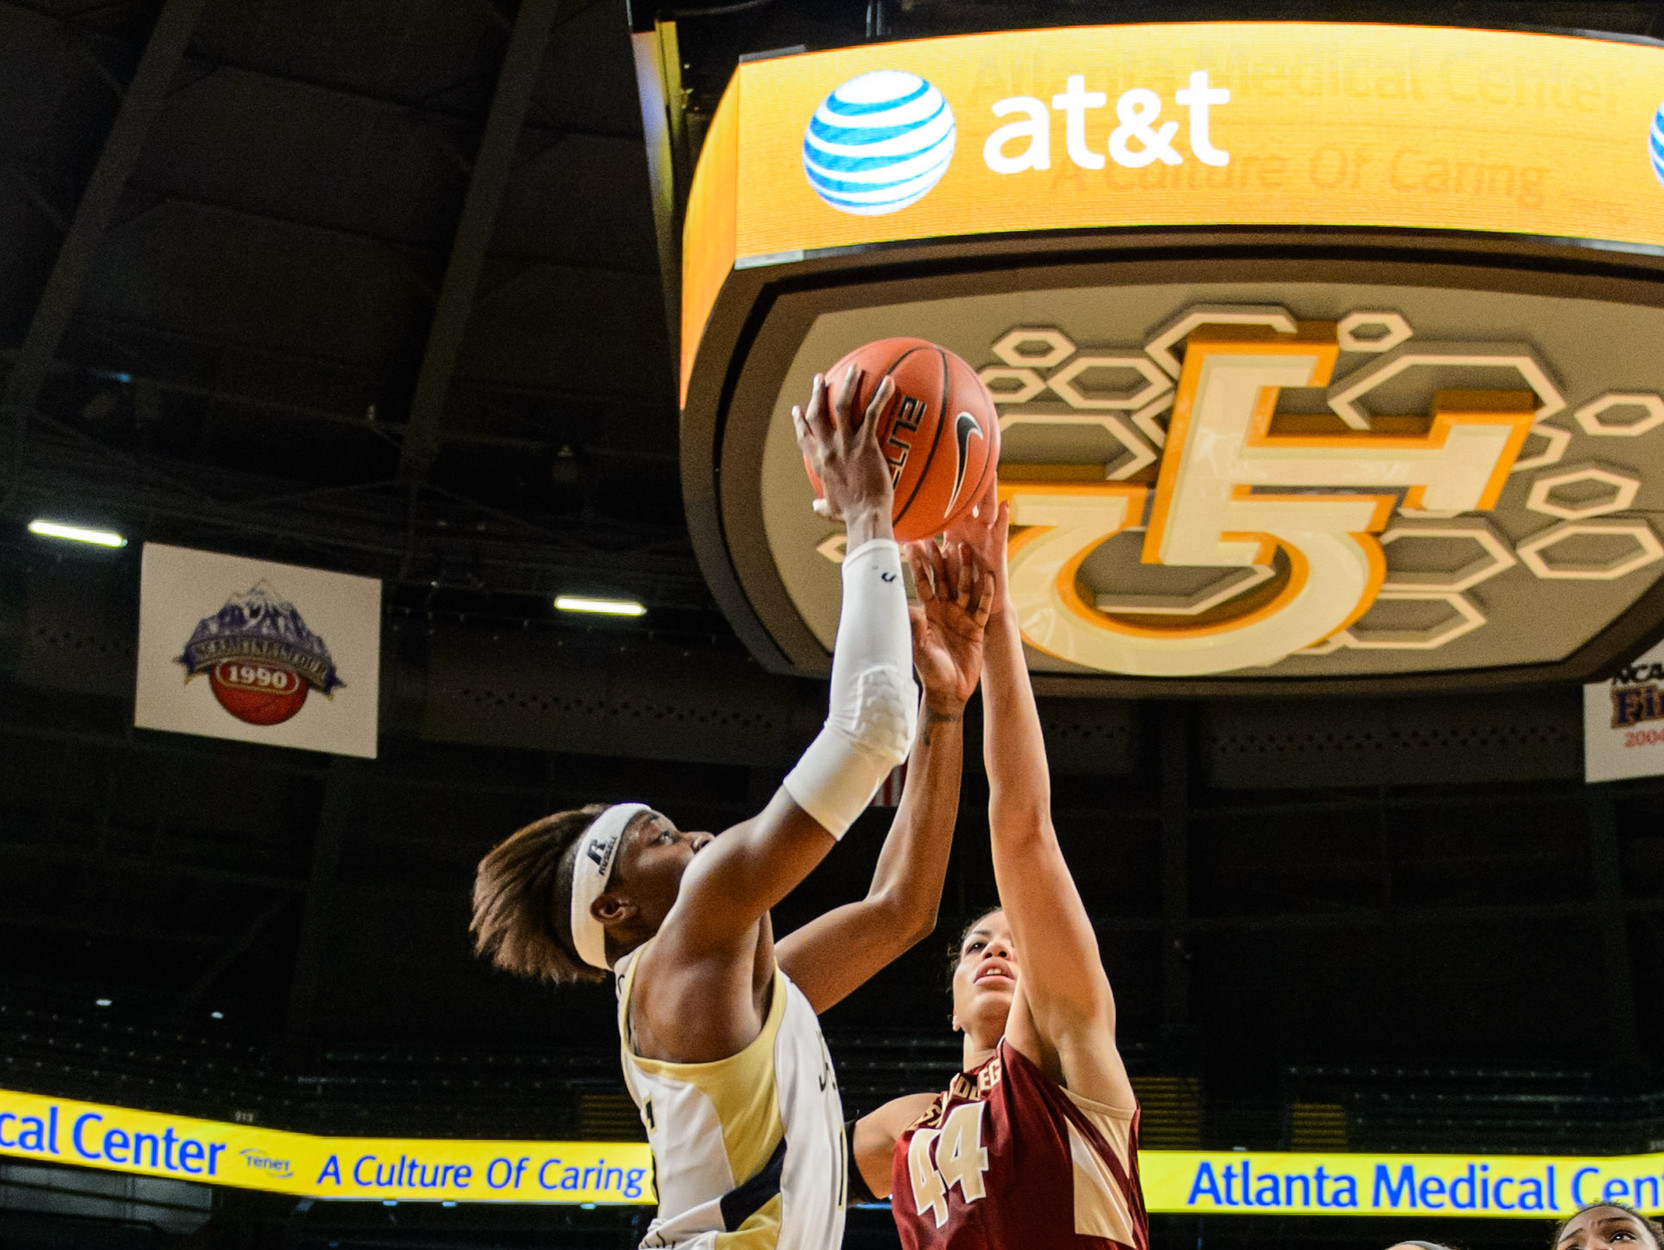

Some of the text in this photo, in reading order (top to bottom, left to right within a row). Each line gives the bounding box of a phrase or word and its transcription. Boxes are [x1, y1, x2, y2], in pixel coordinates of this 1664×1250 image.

[983, 70, 1230, 174] at&t
[1308, 140, 1371, 191] Of
[1389, 146, 1551, 210] Caring
[228, 664, 288, 689] 1990
[0, 1106, 226, 1176] cal Center
[908, 1100, 989, 1229] 44
[317, 1155, 647, 1199] A Culture Of Caring
[1187, 1160, 1664, 1212] Atlanta Medical Cen
